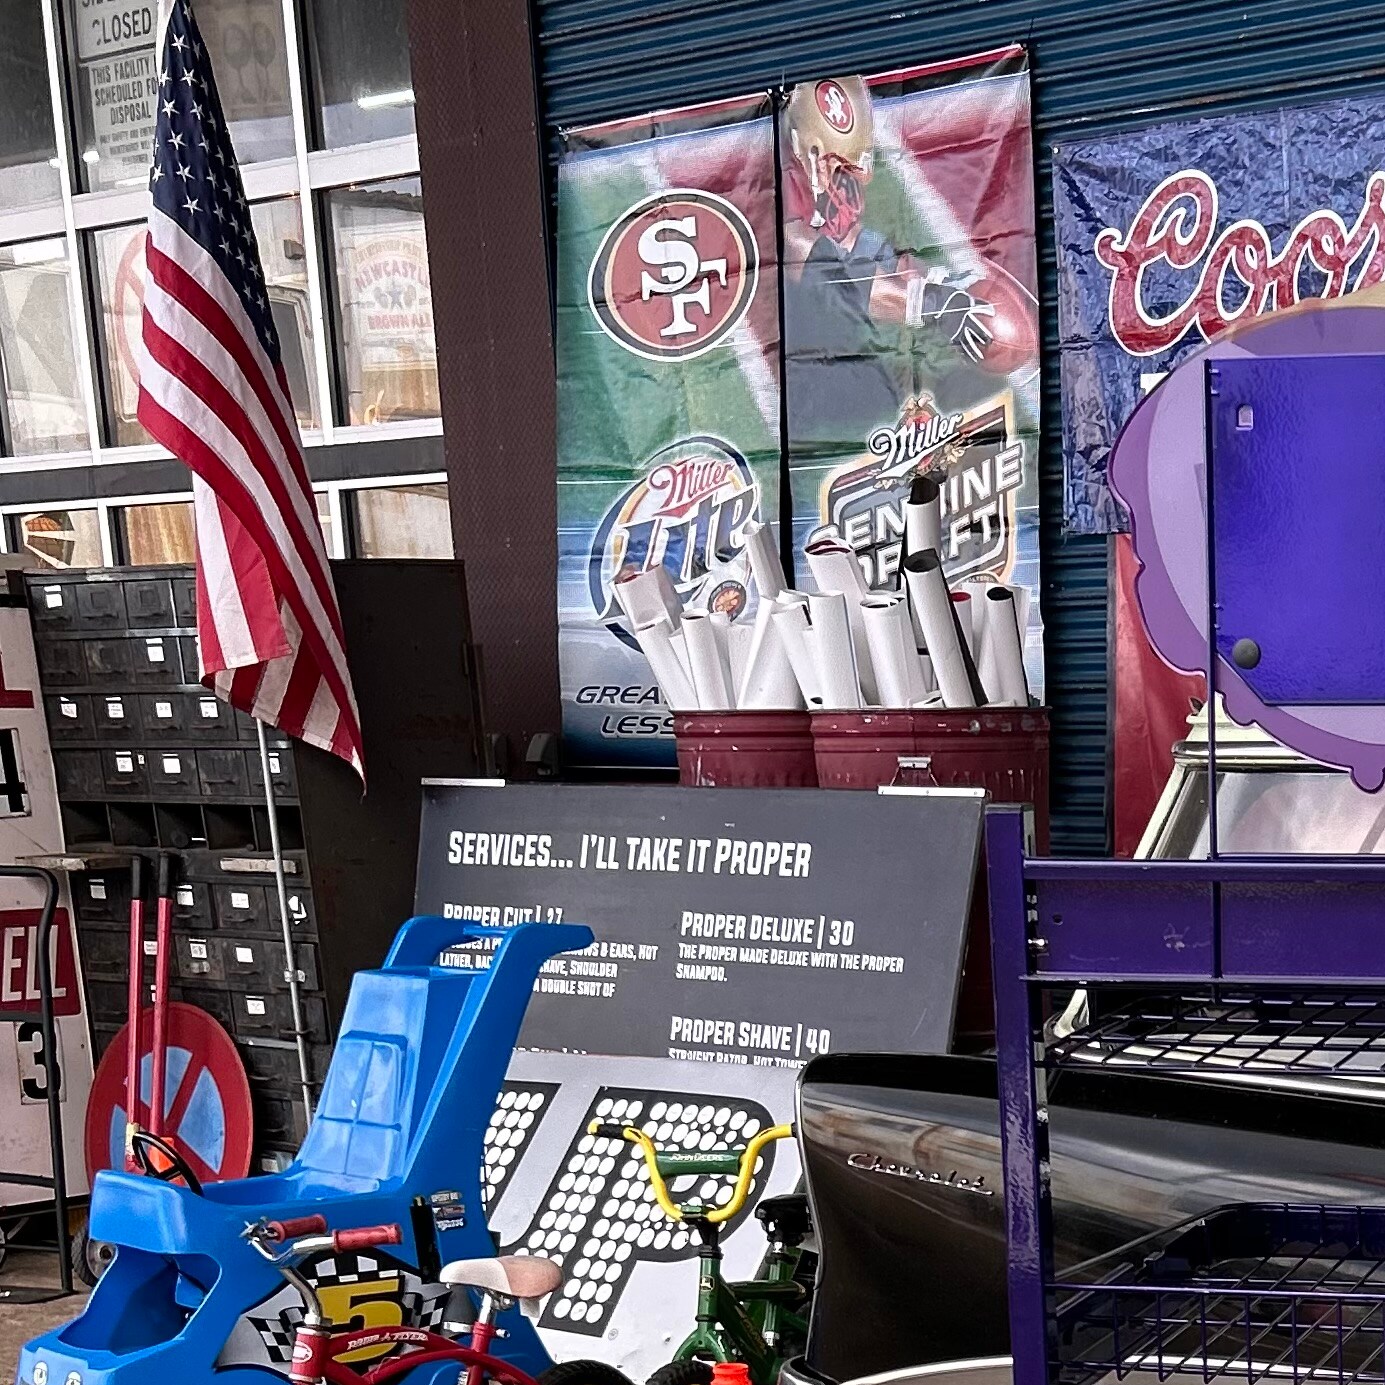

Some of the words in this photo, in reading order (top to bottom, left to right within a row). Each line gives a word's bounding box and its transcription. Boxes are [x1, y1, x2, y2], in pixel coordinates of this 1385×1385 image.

[92, 65, 111, 86] THIS
[114, 56, 150, 82] FACILITY
[95, 80, 144, 107] SCHEDULED
[146, 76, 158, 96] FO
[110, 101, 151, 126] DISPOSAL
[869, 414, 964, 478] Miller
[648, 460, 736, 517] Miller
[576, 685, 668, 705] GREA
[602, 715, 676, 735] LESS
[449, 830, 573, 868] SERVICES...
[580, 834, 620, 870] I'LL
[626, 836, 683, 872] TAKE
[687, 839, 711, 873] IT
[714, 838, 812, 878] PROPER
[681, 911, 747, 940] PROPER
[750, 914, 816, 944] DELUXE
[829, 920, 855, 947] 30
[639, 944, 659, 960] HOT
[678, 943, 697, 960] THE
[698, 945, 738, 962] PROPER
[739, 948, 769, 965] MADE
[770, 949, 809, 967] DELUXE
[811, 951, 838, 969] WITH
[840, 953, 860, 971] THE
[861, 954, 905, 973] PROPER
[570, 961, 618, 979] SHOULDER
[676, 962, 728, 982] SHAMPOO.
[542, 978, 577, 993] DOUBLE
[578, 980, 602, 997] SHOT
[602, 983, 616, 998] OF
[670, 1015, 736, 1046] PROPER
[738, 1021, 793, 1051] SHAVE
[805, 1029, 831, 1054] 40
[847, 1153, 994, 1196] Chevrolet
[316, 1278, 403, 1363] 5
